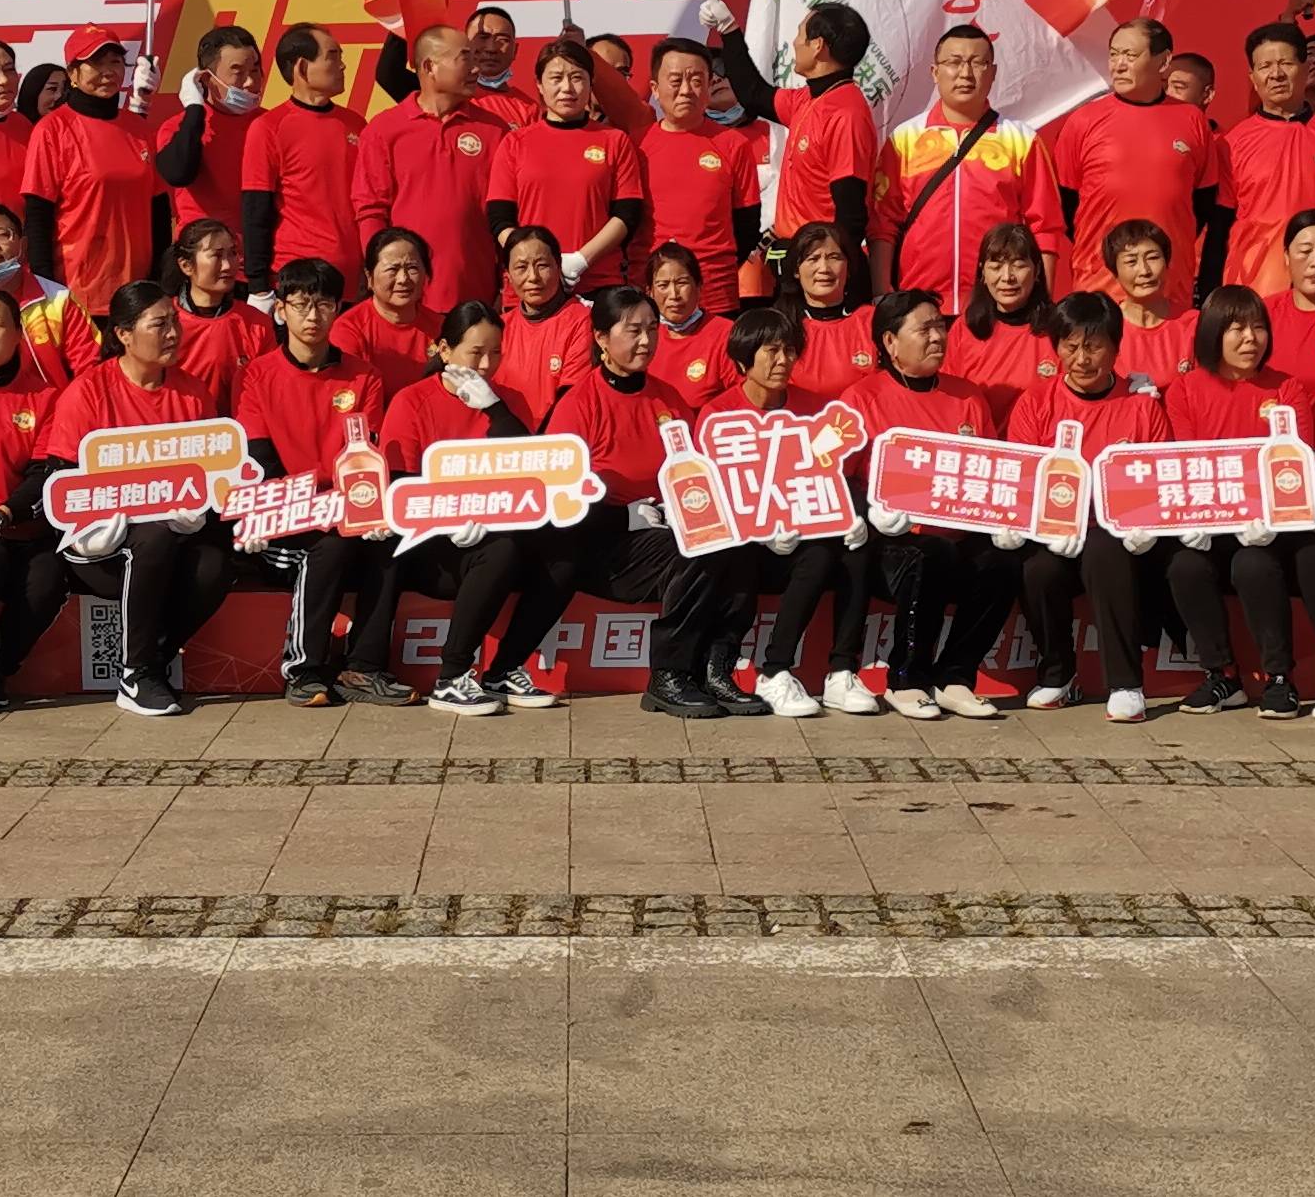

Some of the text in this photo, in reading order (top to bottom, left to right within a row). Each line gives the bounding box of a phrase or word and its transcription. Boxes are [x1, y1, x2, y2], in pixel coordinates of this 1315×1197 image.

[97, 431, 233, 468] 确认过眼神
[440, 448, 575, 477] 确认过眼神
[904, 444, 1022, 484] 中国劲酒
[1124, 455, 1245, 484] 中国劲酒
[64, 478, 202, 514] 是能跑的人
[225, 472, 317, 517] 给生活
[404, 489, 541, 521] 是能跑的人
[931, 475, 1019, 508] 我爱你
[1158, 480, 1246, 508] 我爱你
[238, 491, 345, 543] 加把劲
